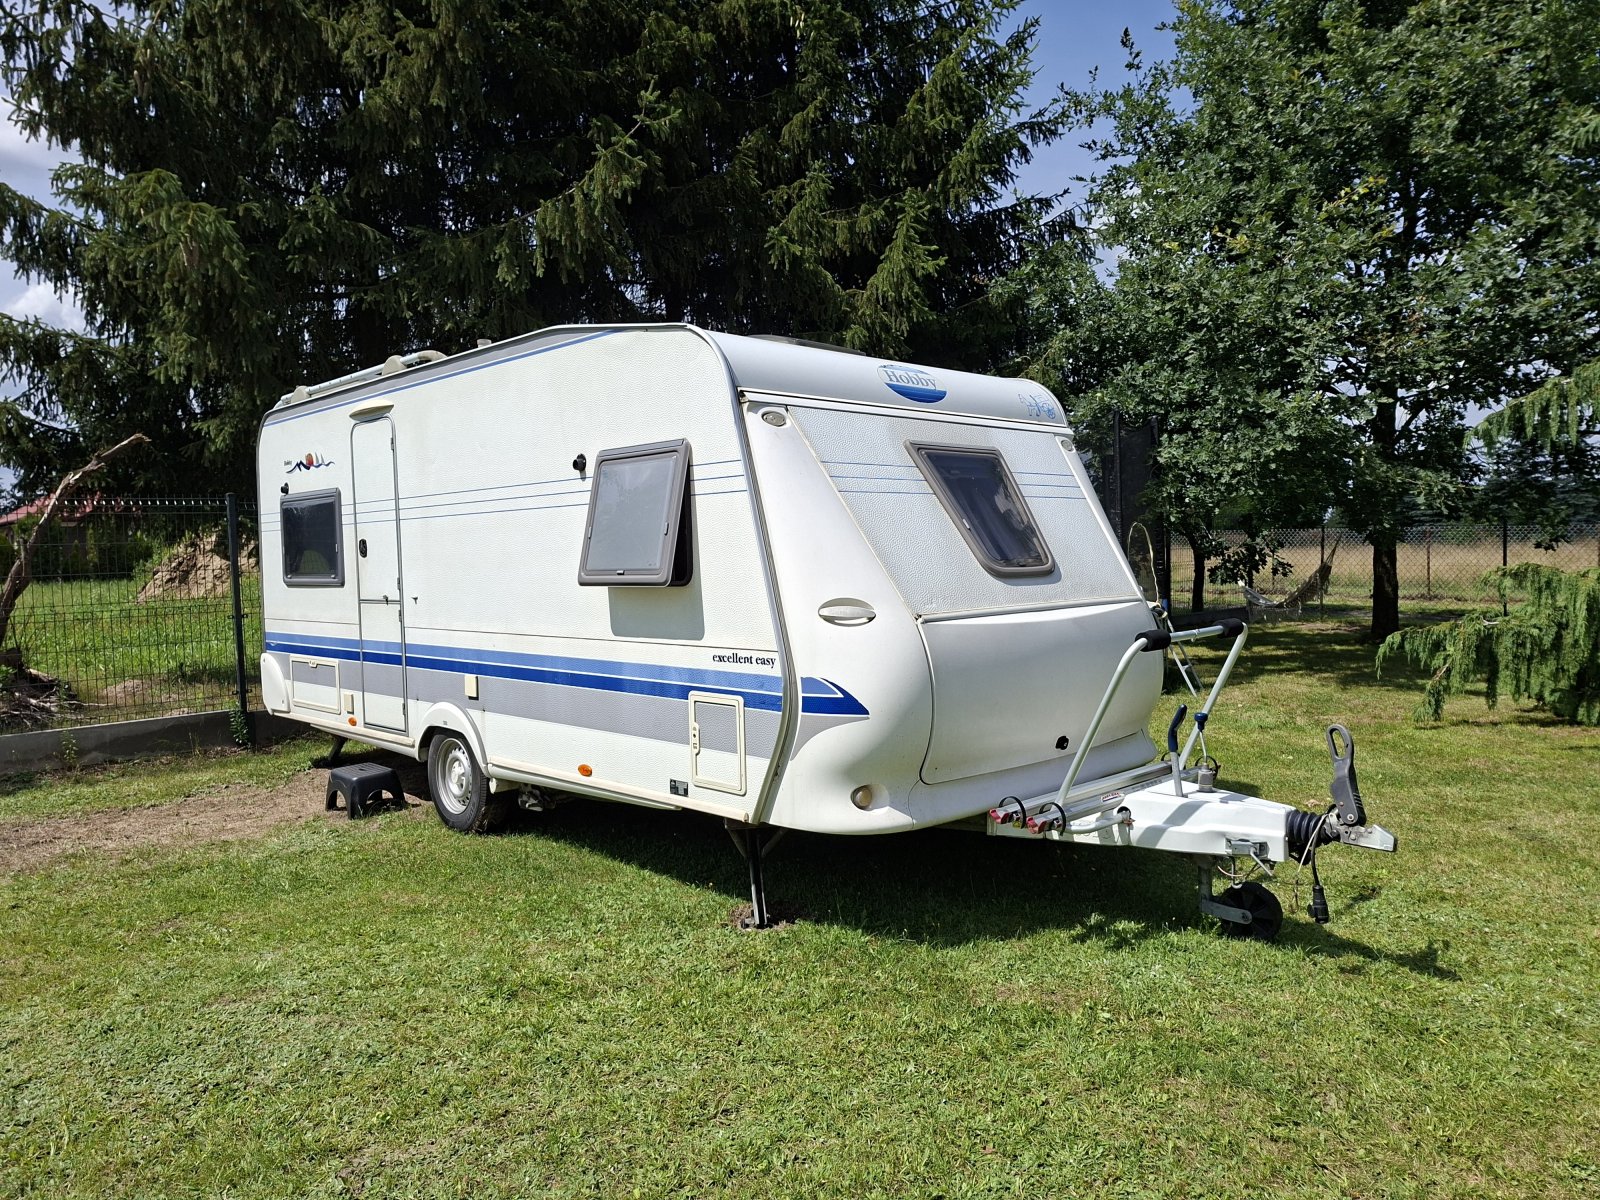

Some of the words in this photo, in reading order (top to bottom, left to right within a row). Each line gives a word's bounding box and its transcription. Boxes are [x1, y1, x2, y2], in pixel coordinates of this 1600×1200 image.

[883, 369, 937, 390] Hobby
[712, 652, 753, 665] excellent
[755, 656, 776, 669] easy
